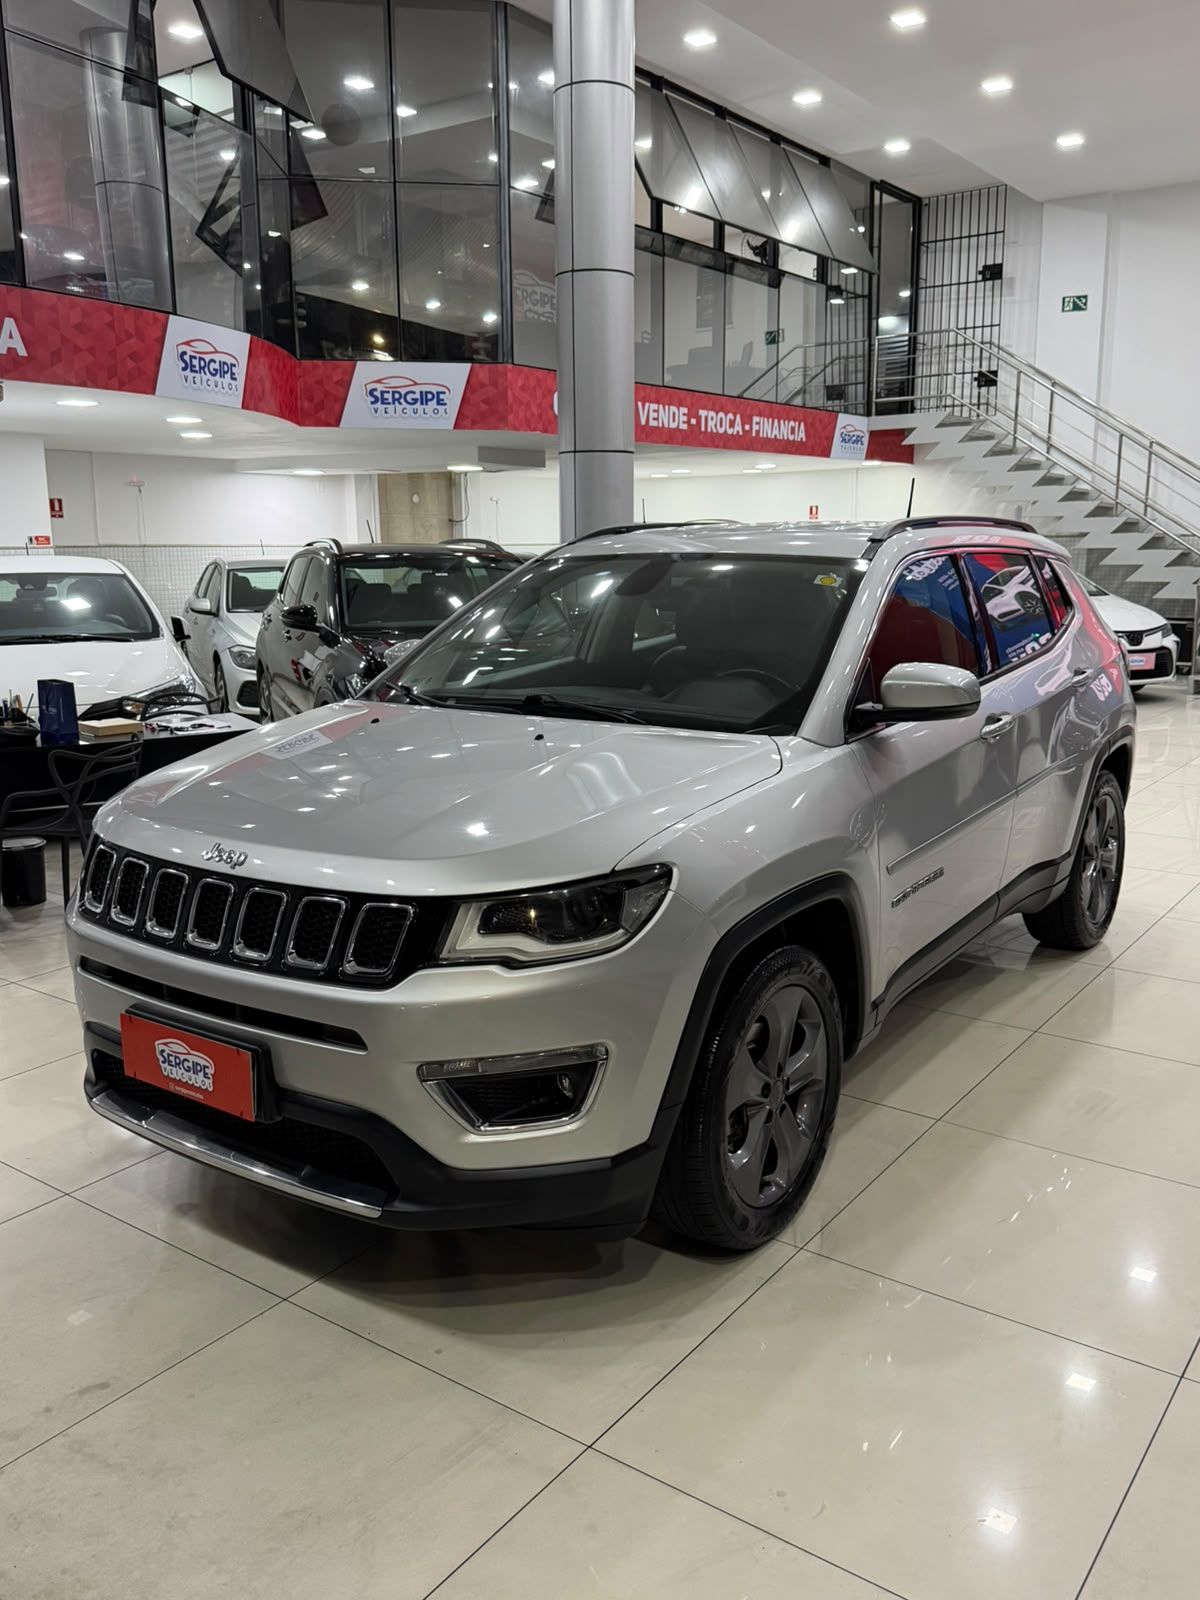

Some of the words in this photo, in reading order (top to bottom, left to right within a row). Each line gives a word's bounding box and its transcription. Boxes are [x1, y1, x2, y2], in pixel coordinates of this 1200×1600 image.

[179, 350, 238, 381] SERGIPE
[368, 387, 447, 406] SERGIPE
[638, 401, 688, 430] VENDE
[699, 409, 743, 436] TROCA
[752, 415, 806, 442] FINANCIA
[201, 842, 248, 870] Jeep
[160, 1049, 211, 1080] SERGIPE
